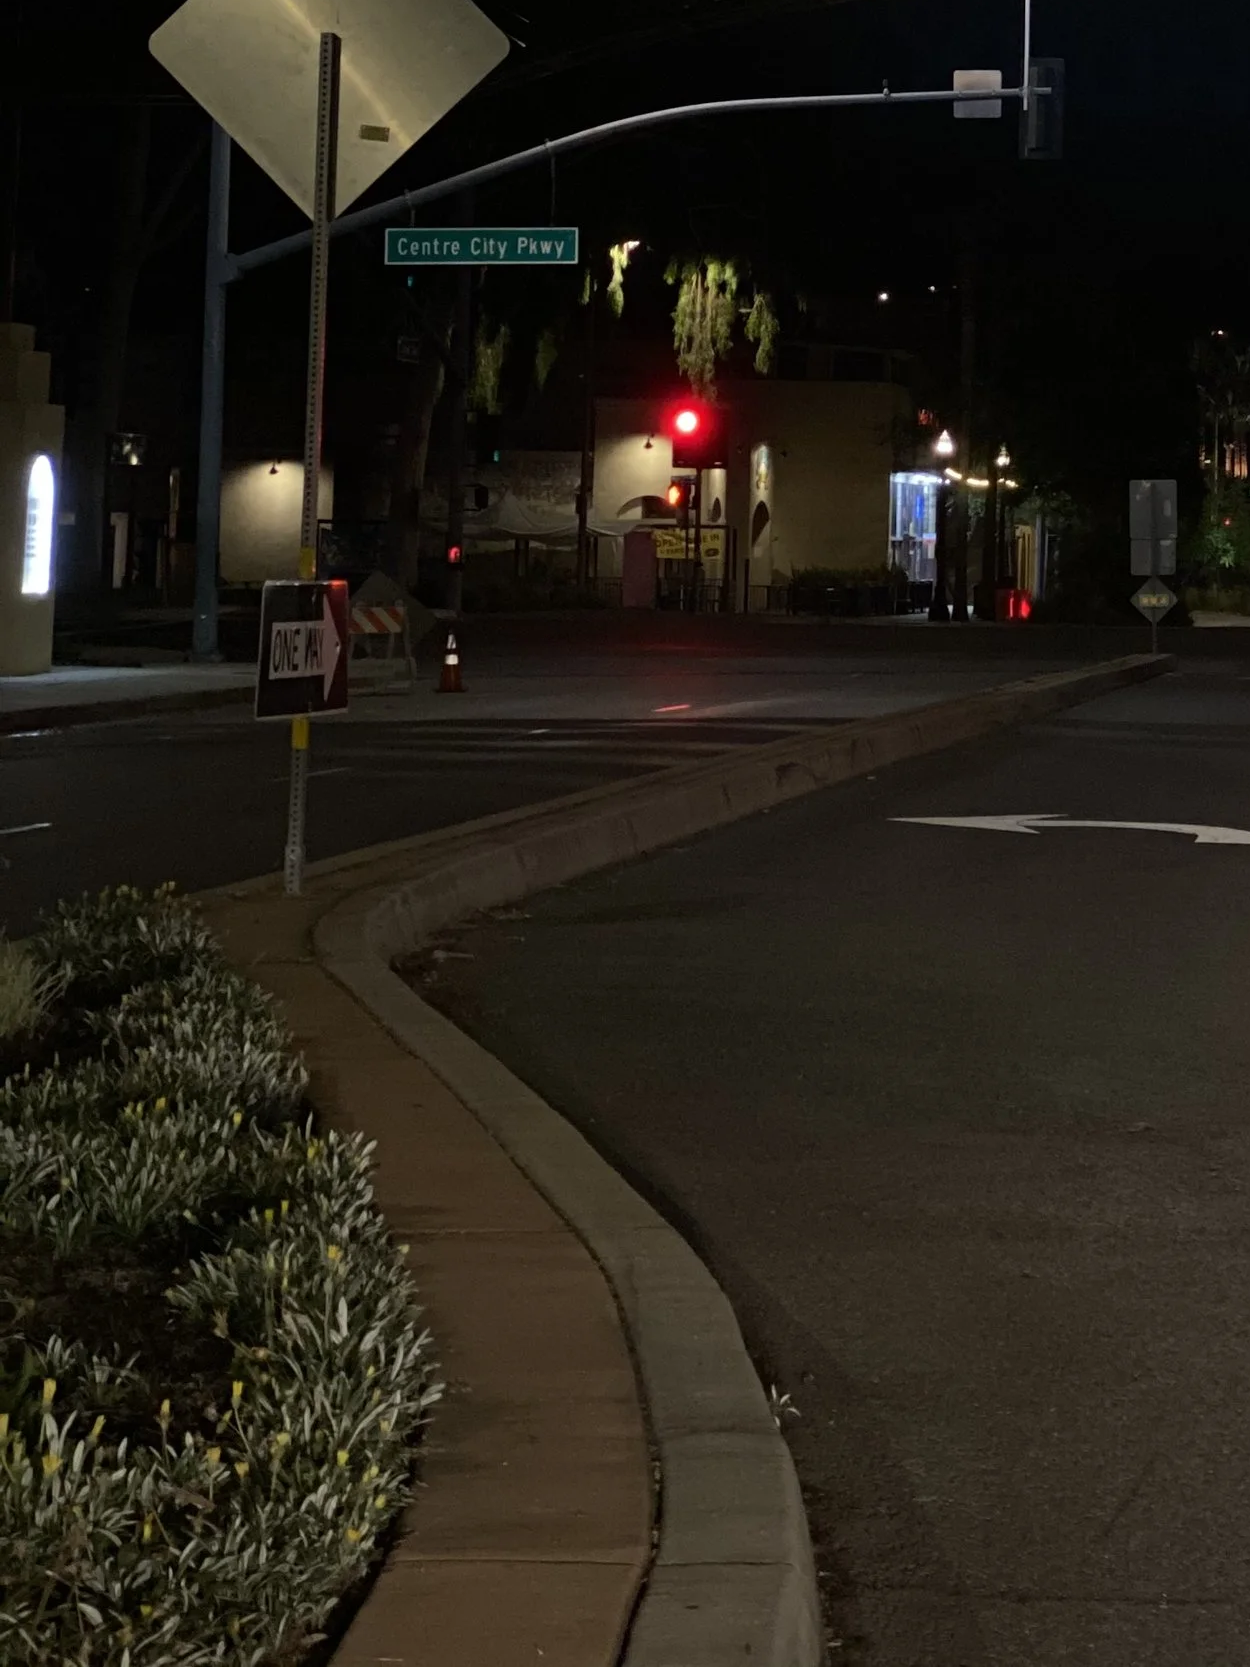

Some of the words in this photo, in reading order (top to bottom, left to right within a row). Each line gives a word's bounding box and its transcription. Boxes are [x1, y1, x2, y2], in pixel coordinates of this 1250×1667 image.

[398, 238, 460, 256] Centre
[470, 237, 508, 259] City
[517, 237, 565, 259] Pkwy
[273, 628, 300, 673] ONE
[305, 627, 325, 670] WAY
